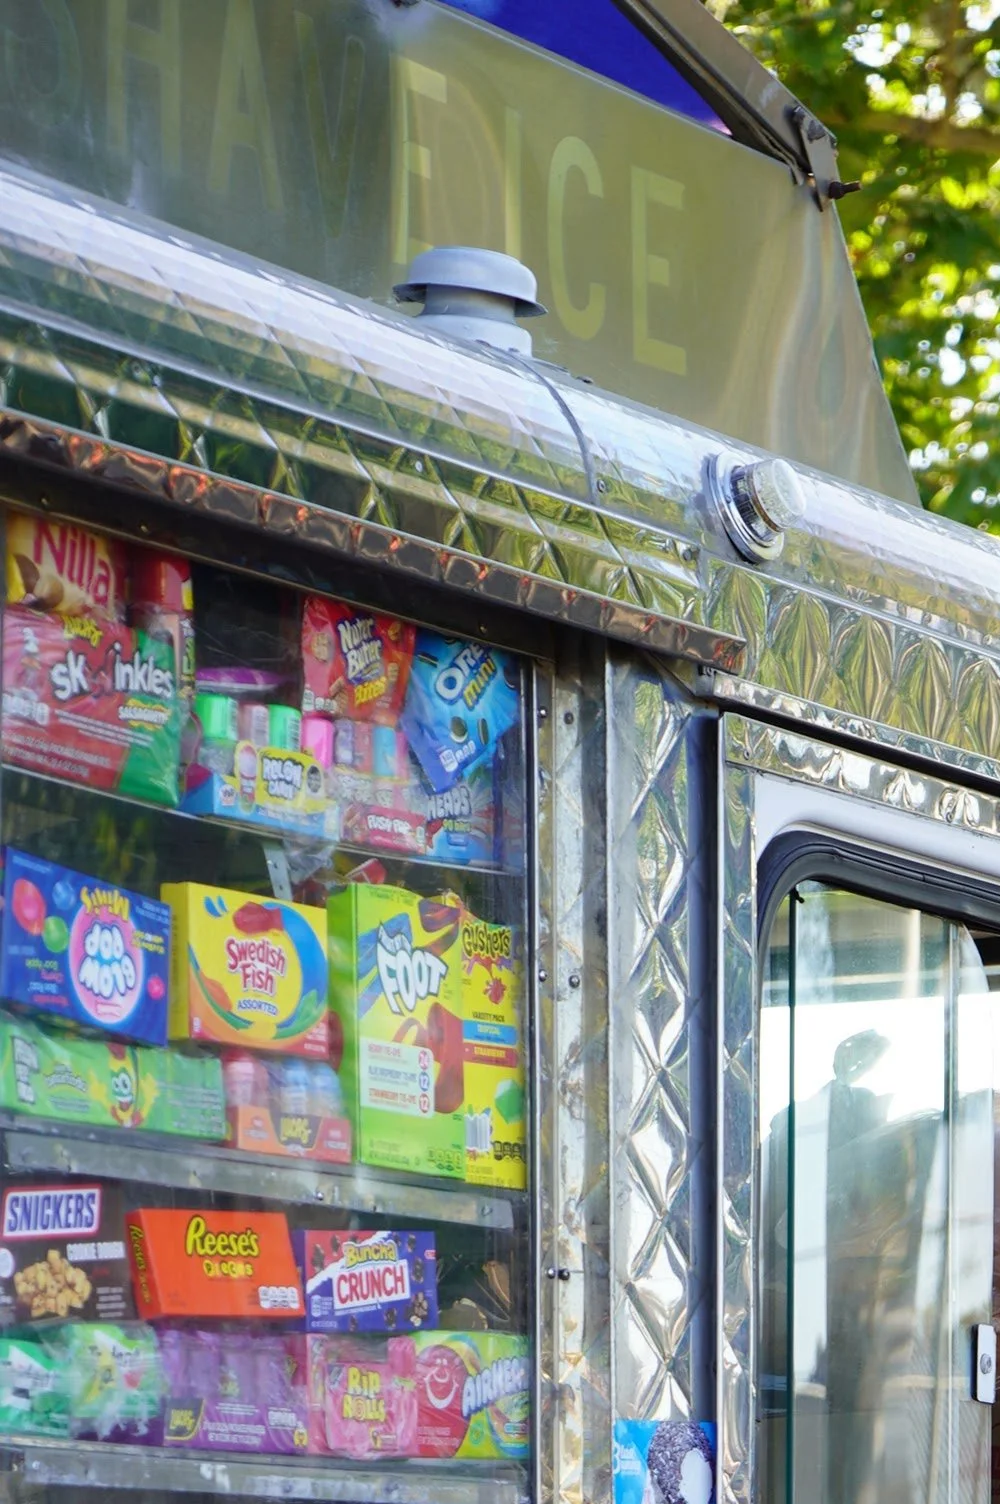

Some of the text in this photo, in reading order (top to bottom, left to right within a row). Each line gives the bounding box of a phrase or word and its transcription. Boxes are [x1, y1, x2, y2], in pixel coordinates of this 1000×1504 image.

[33, 517, 111, 606] Nilla
[225, 937, 287, 976] Swedish
[239, 963, 275, 995] Fish
[376, 943, 449, 1016] FOOT
[7, 1191, 97, 1233] SNICKERS
[337, 1264, 406, 1305] CRUNCH
